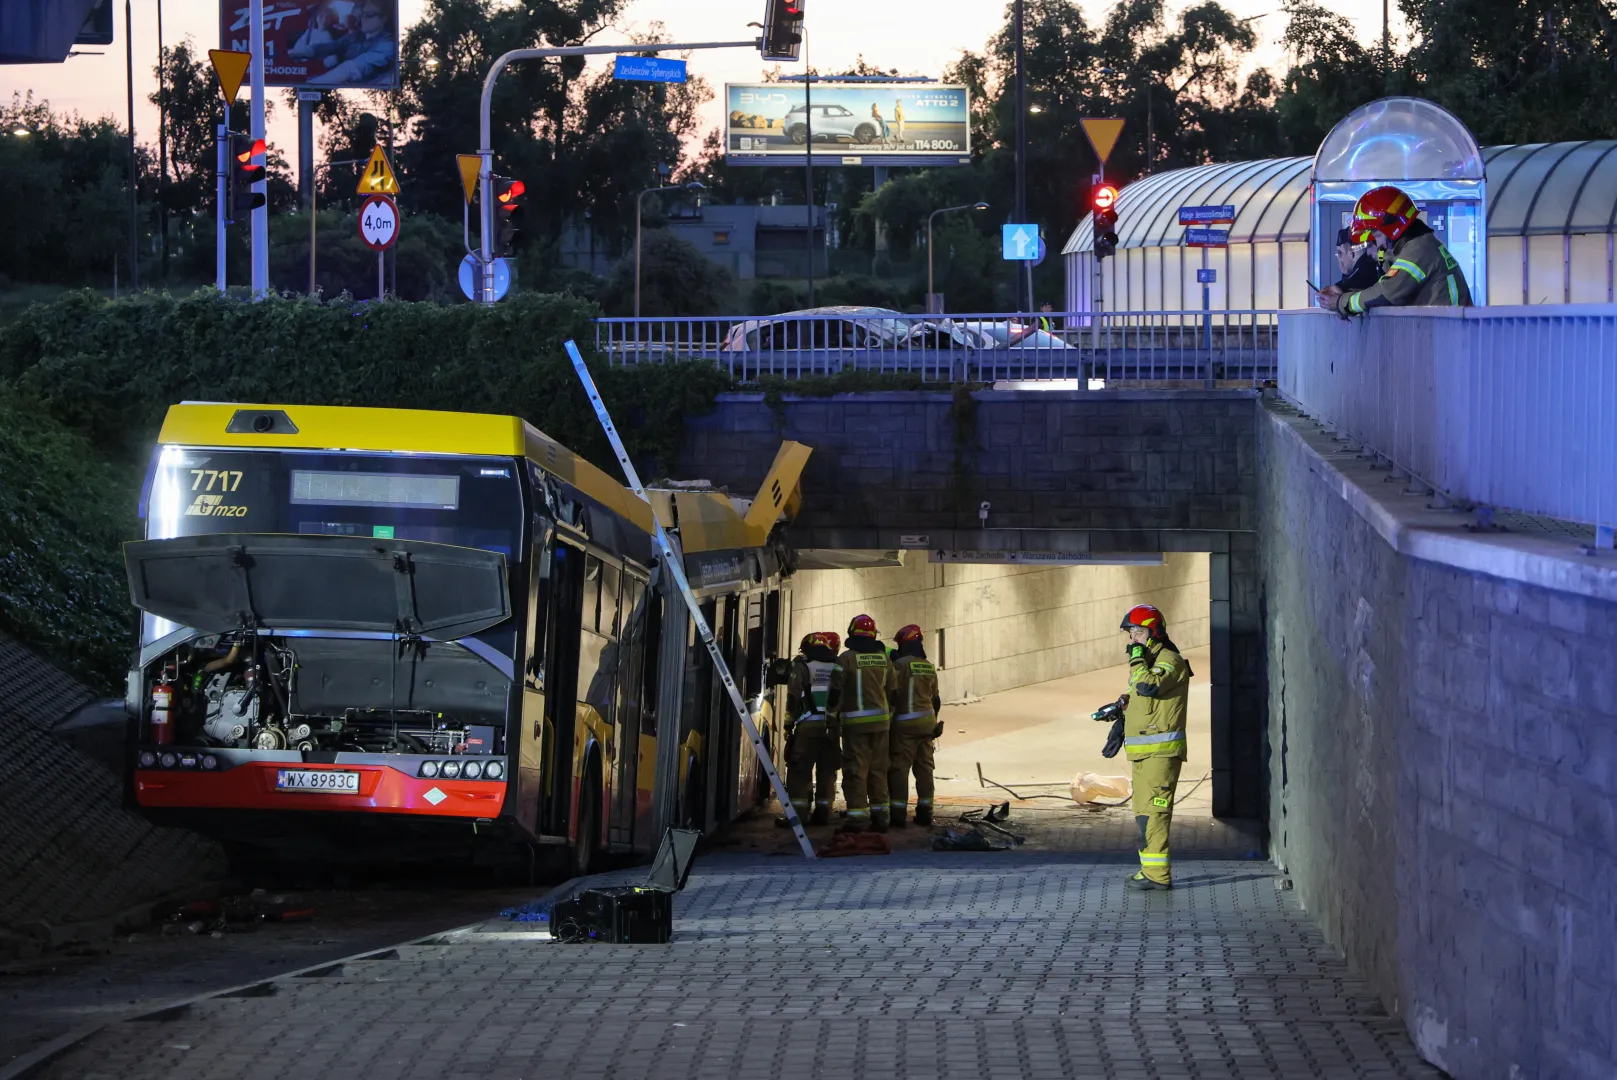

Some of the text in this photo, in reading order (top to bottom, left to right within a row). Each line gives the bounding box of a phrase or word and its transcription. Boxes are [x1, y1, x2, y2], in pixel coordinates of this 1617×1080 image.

[740, 93, 788, 104] BYD
[191, 470, 243, 492] 7717
[1022, 552, 1056, 560] Warszawa
[1057, 552, 1092, 560] Zachodnia
[287, 773, 305, 787] WX
